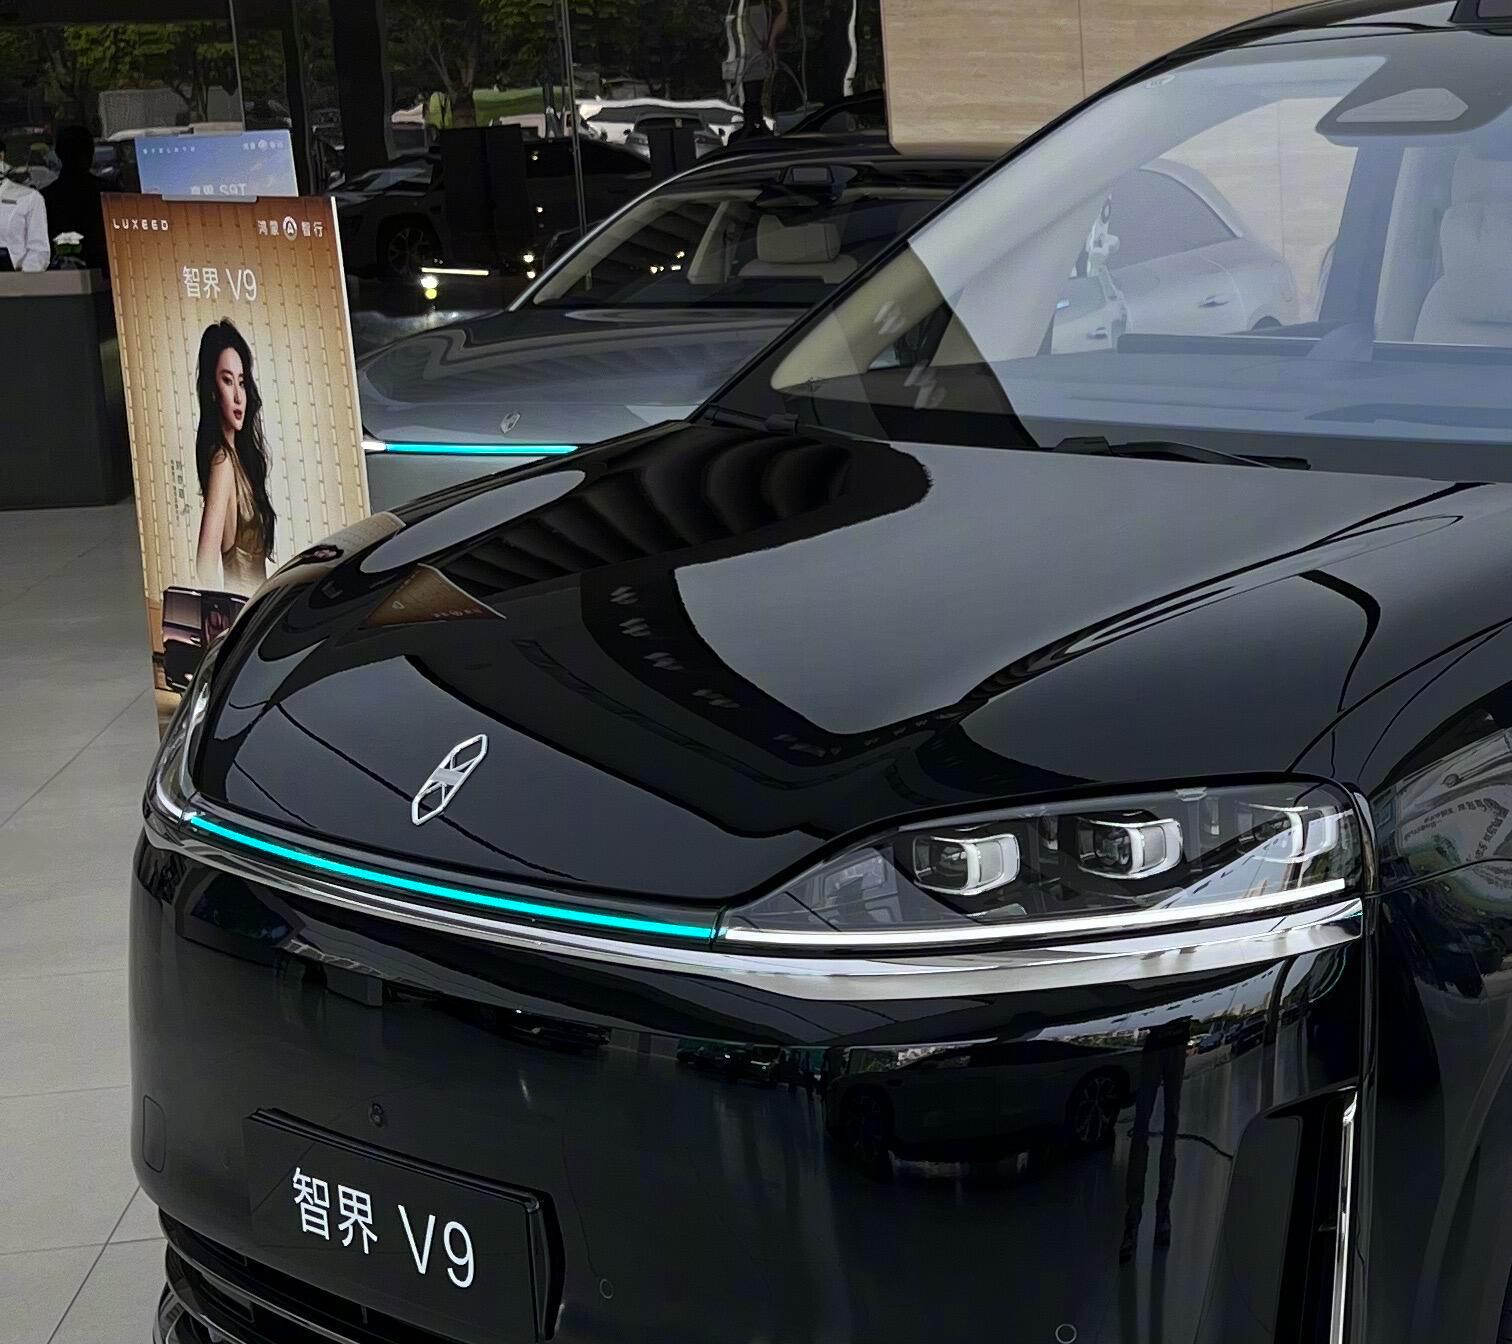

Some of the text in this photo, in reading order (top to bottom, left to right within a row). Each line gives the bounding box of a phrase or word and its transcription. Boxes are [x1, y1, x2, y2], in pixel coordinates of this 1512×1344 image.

[112, 218, 169, 231] LUXEED
[183, 265, 257, 301] 智界 V9
[292, 1167, 475, 1288] 智界 V9
